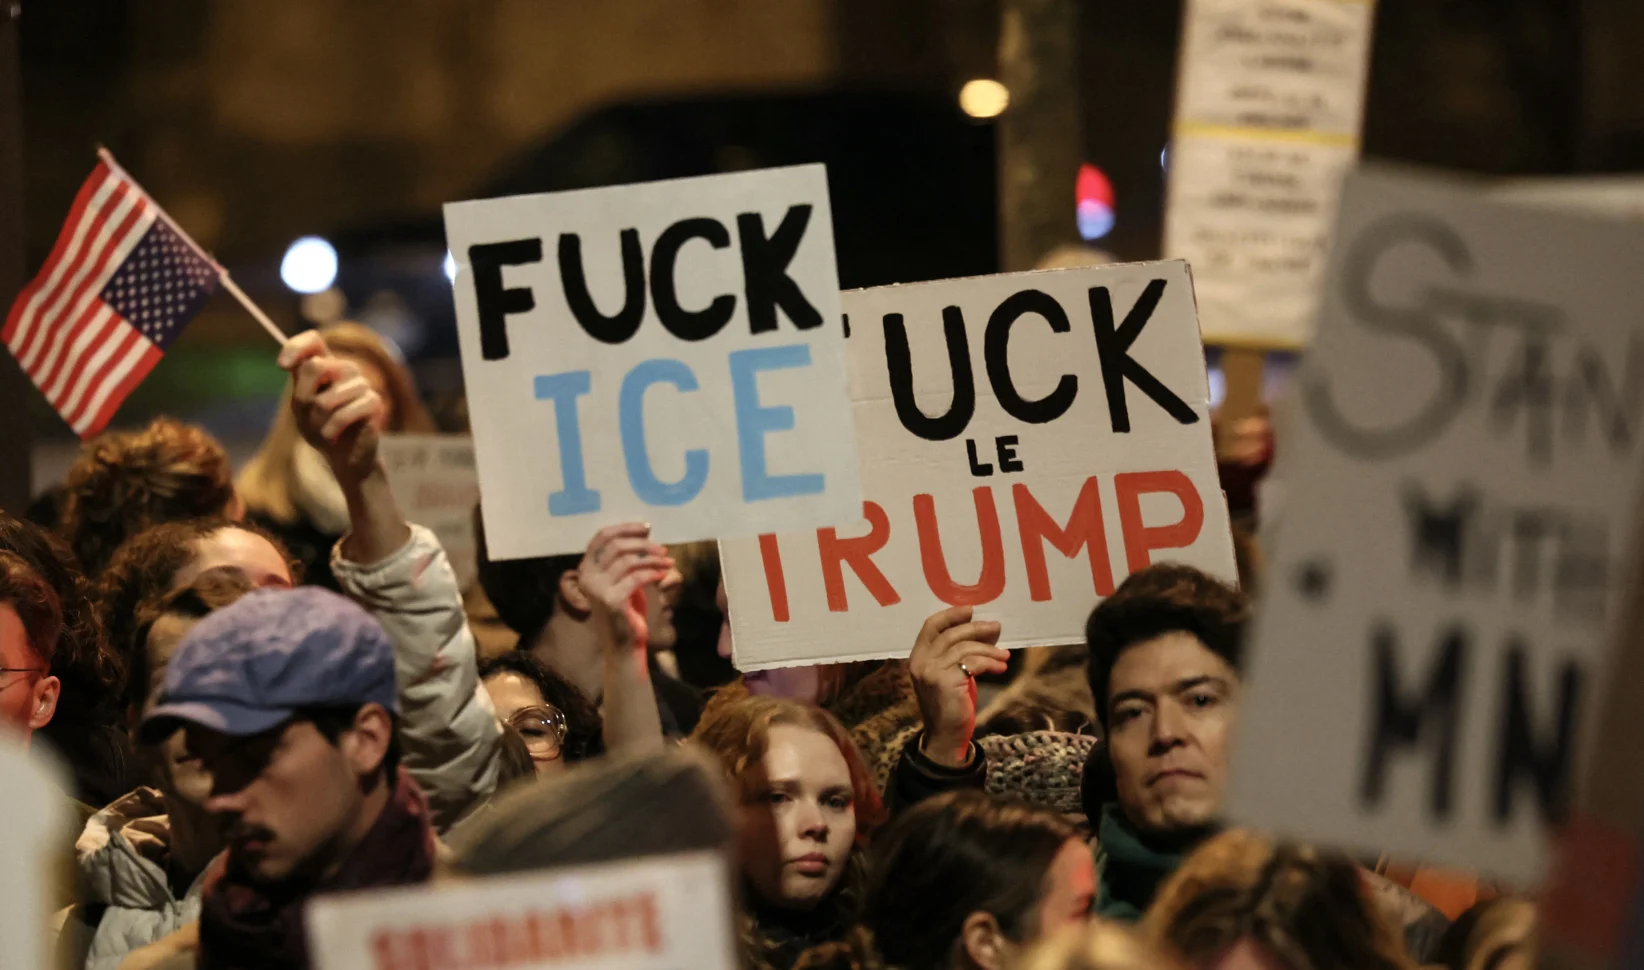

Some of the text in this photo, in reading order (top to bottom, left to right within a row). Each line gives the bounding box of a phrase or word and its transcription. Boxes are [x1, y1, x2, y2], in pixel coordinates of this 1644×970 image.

[468, 204, 824, 361] FUCK
[842, 278, 1200, 441] UCK
[534, 343, 826, 516] ICE
[966, 435, 1024, 477] LE
[1353, 616, 1586, 832] MN
